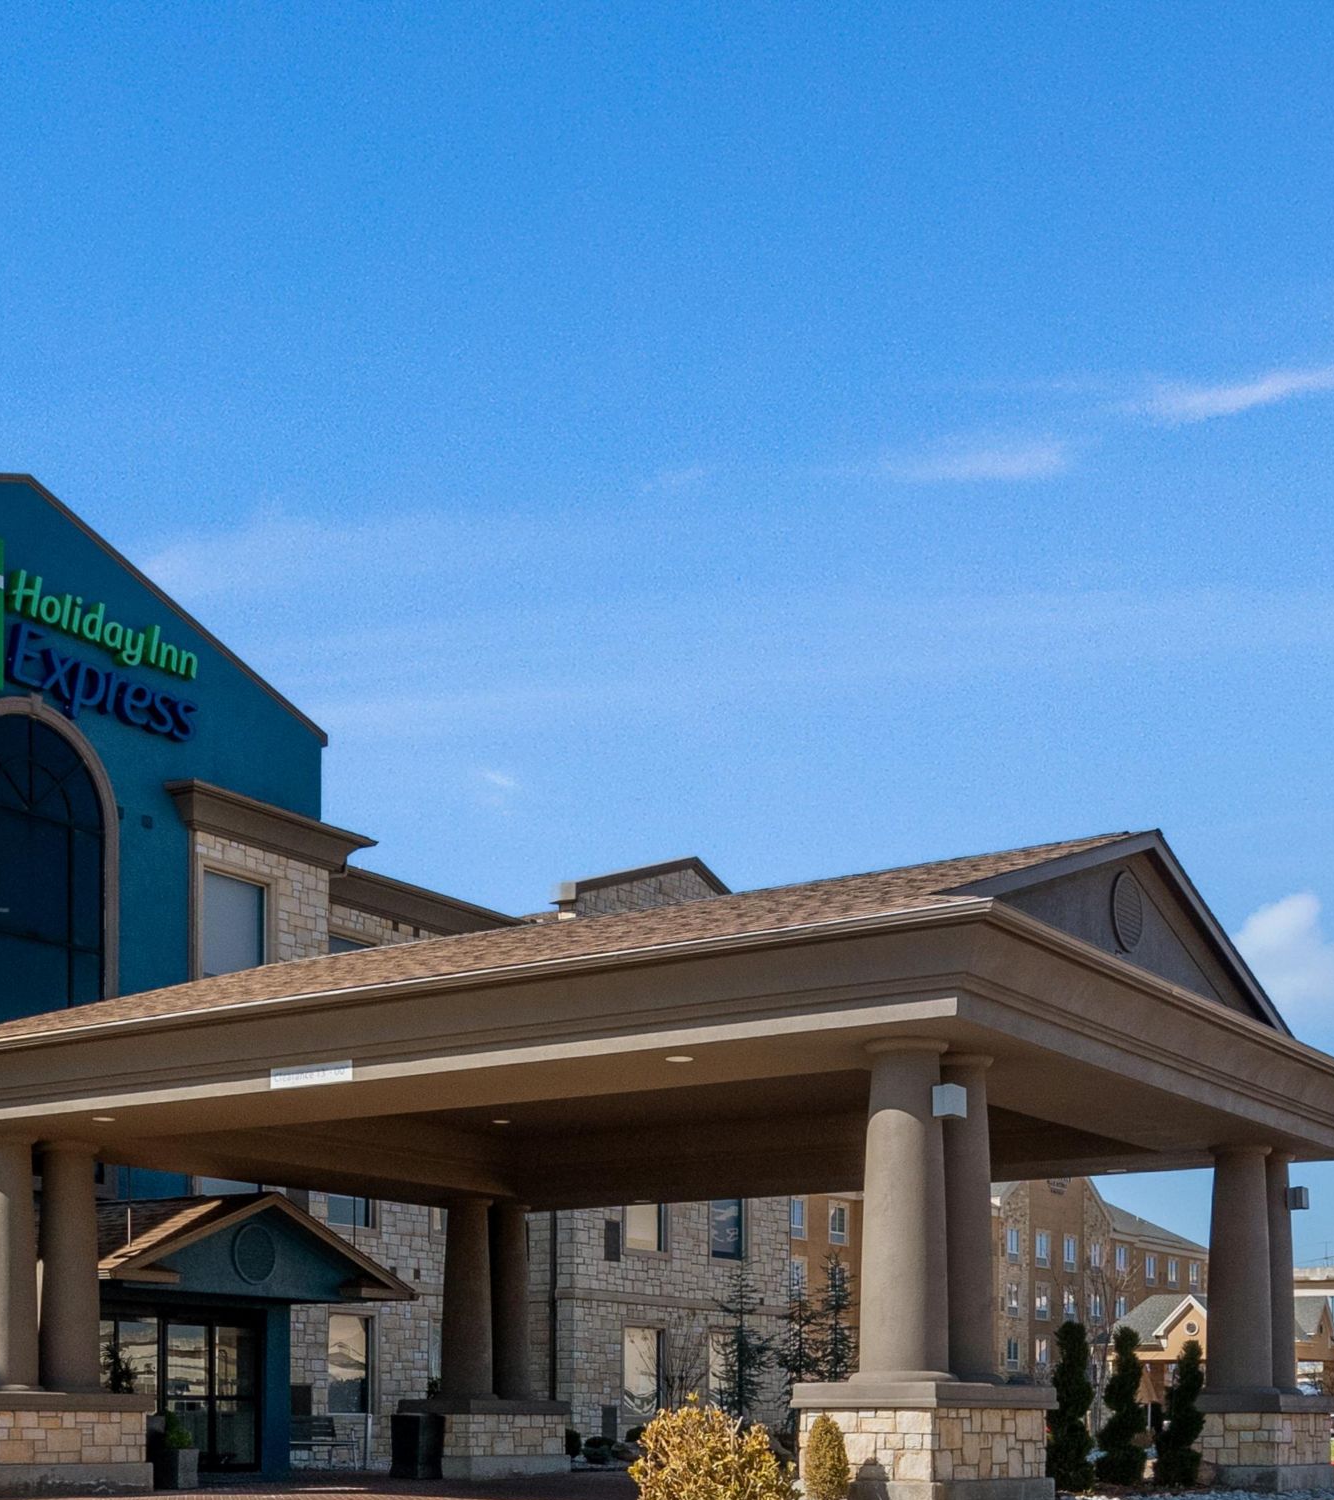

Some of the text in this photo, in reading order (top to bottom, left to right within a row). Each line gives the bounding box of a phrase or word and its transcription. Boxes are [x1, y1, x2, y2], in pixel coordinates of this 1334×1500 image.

[7, 622, 198, 742] Express
[10, 569, 198, 680] Holiday Inn
